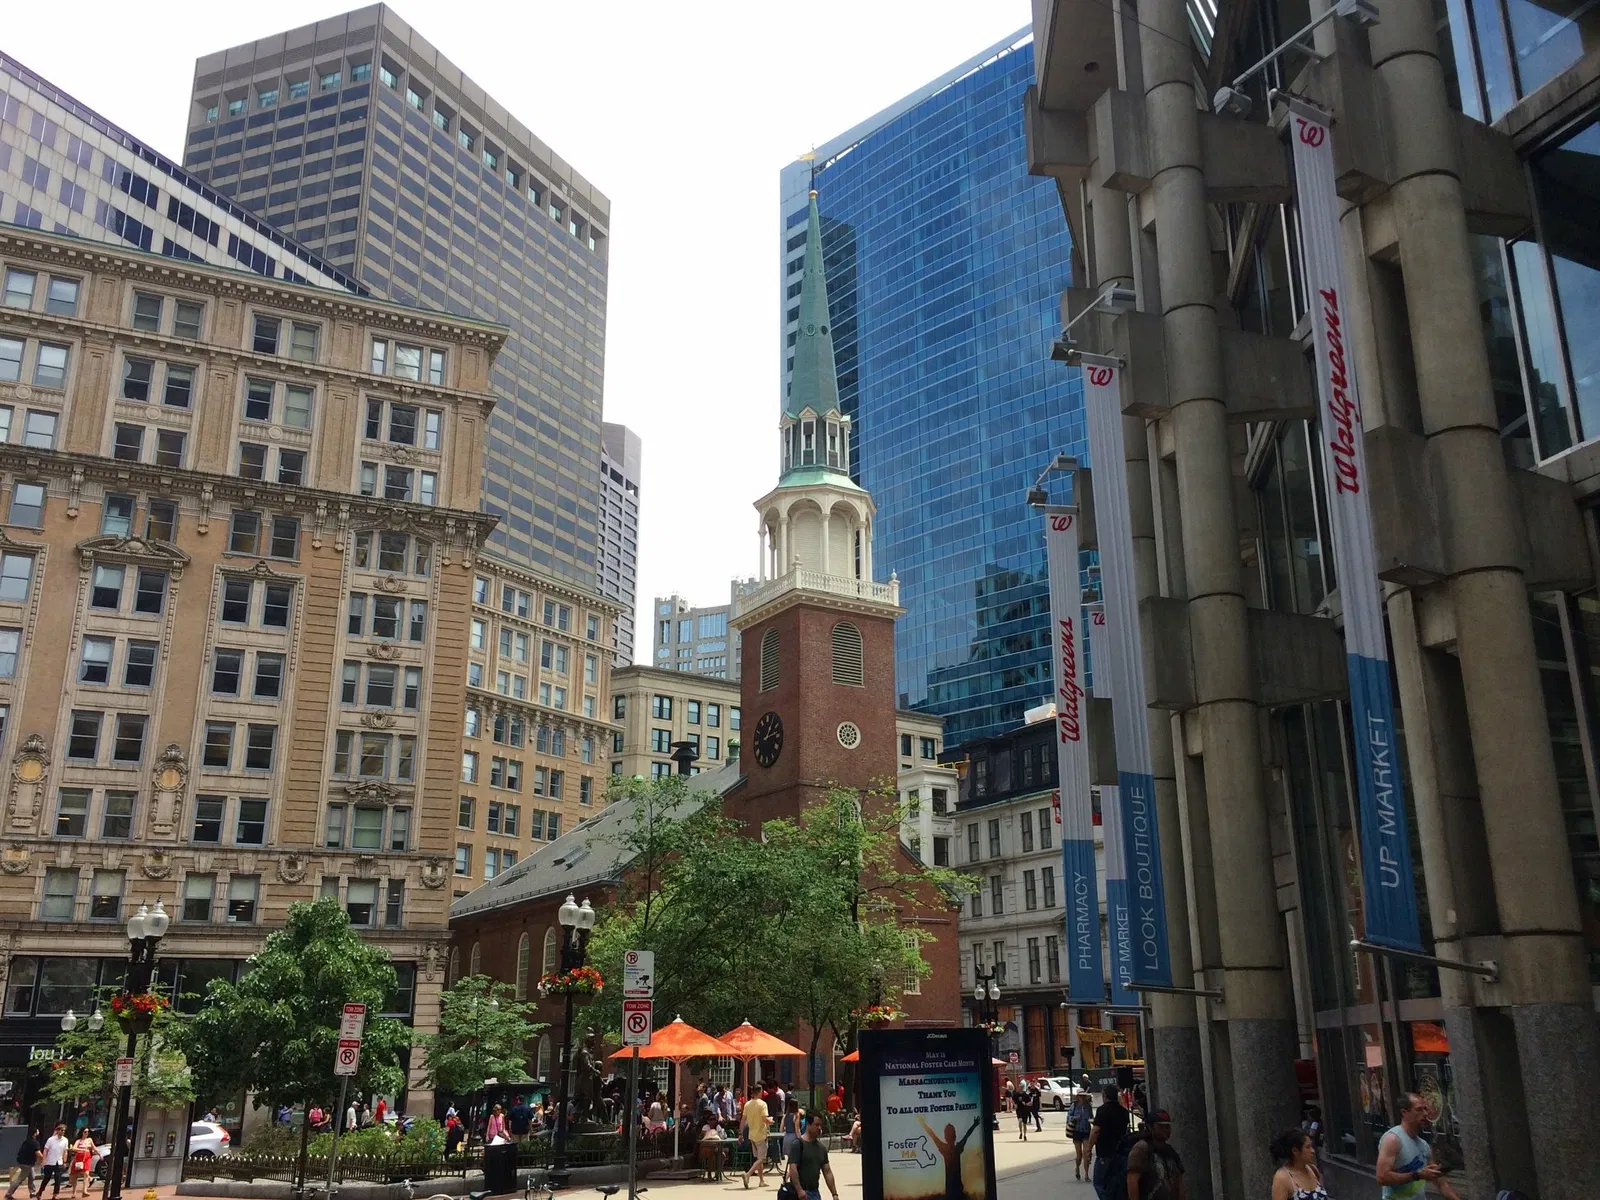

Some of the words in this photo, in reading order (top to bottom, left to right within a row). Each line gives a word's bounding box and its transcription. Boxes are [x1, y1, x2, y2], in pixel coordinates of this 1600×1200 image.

[1319, 287, 1361, 494] Walgreens
[1058, 616, 1084, 744] Walgreens
[1367, 709, 1396, 836] MARKET
[1130, 786, 1153, 900] BOUTIQUE
[1380, 845, 1400, 889] UP
[1074, 871, 1092, 970] PHARMACY
[1115, 904, 1131, 963] MARKET
[1140, 907, 1159, 970] LOOK
[1119, 966, 1133, 986] UP
[885, 1062, 920, 1070] NATIONAL
[920, 1061, 943, 1069] FOSTER
[917, 1090, 942, 1099] THANK
[942, 1089, 957, 1098] YOU
[899, 1106, 913, 1114] ALL
[914, 1105, 929, 1113] OUR
[930, 1104, 954, 1113] FOSTER
[887, 1140, 918, 1150] Foster
